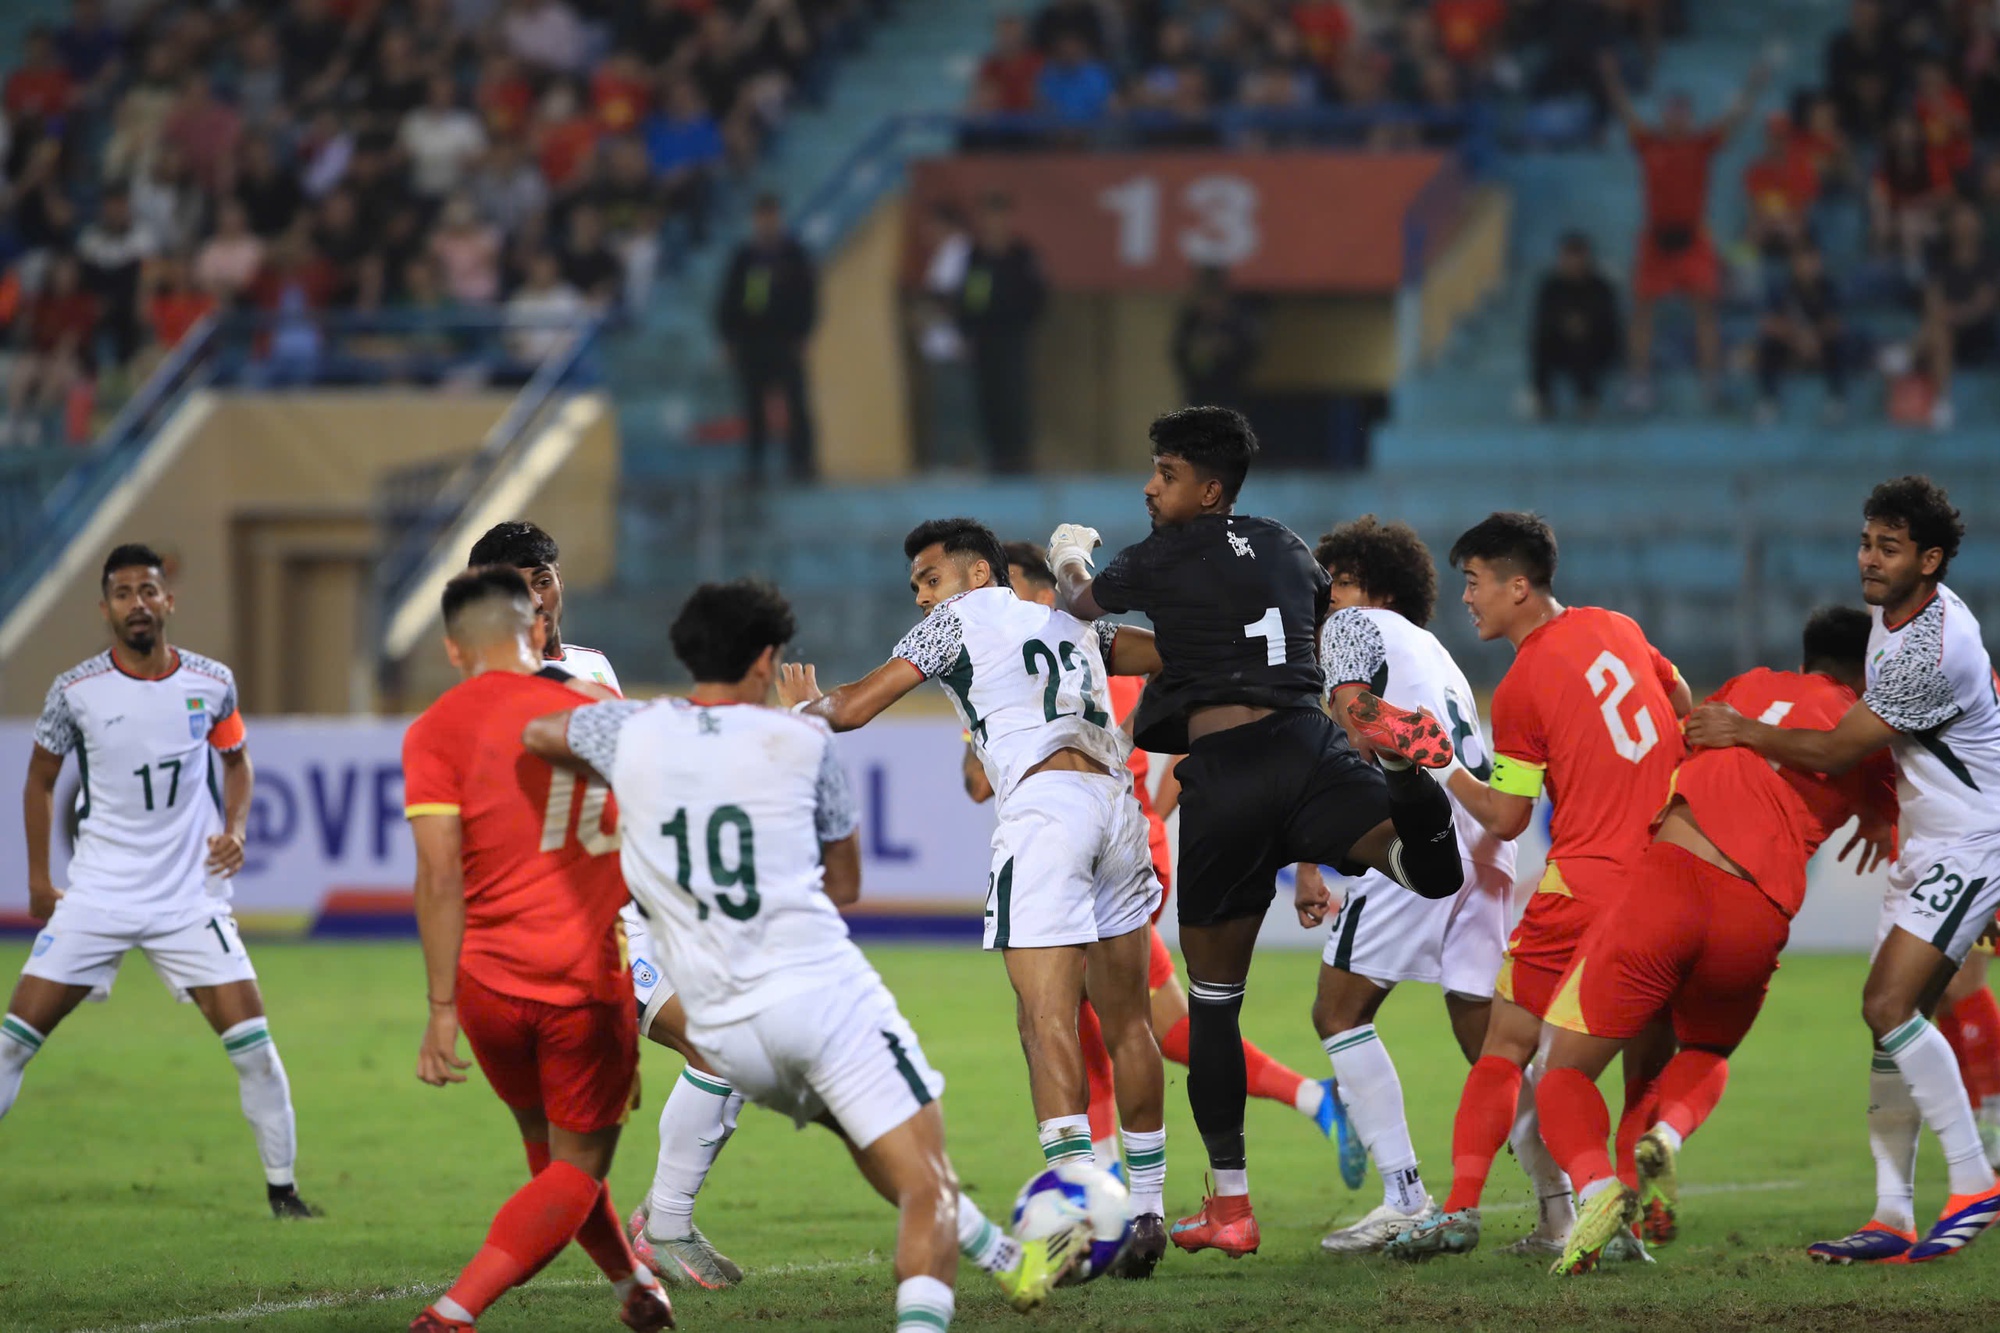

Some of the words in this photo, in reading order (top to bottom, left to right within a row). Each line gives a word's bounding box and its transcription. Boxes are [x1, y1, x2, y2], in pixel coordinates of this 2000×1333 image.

[1099, 174, 1260, 265] 13
[1244, 607, 1287, 666] 1
[1022, 639, 1108, 728] 22
[1584, 650, 1659, 764] 2
[133, 759, 182, 811] 17
[661, 805, 760, 921] 19
[1910, 863, 1964, 912] 23
